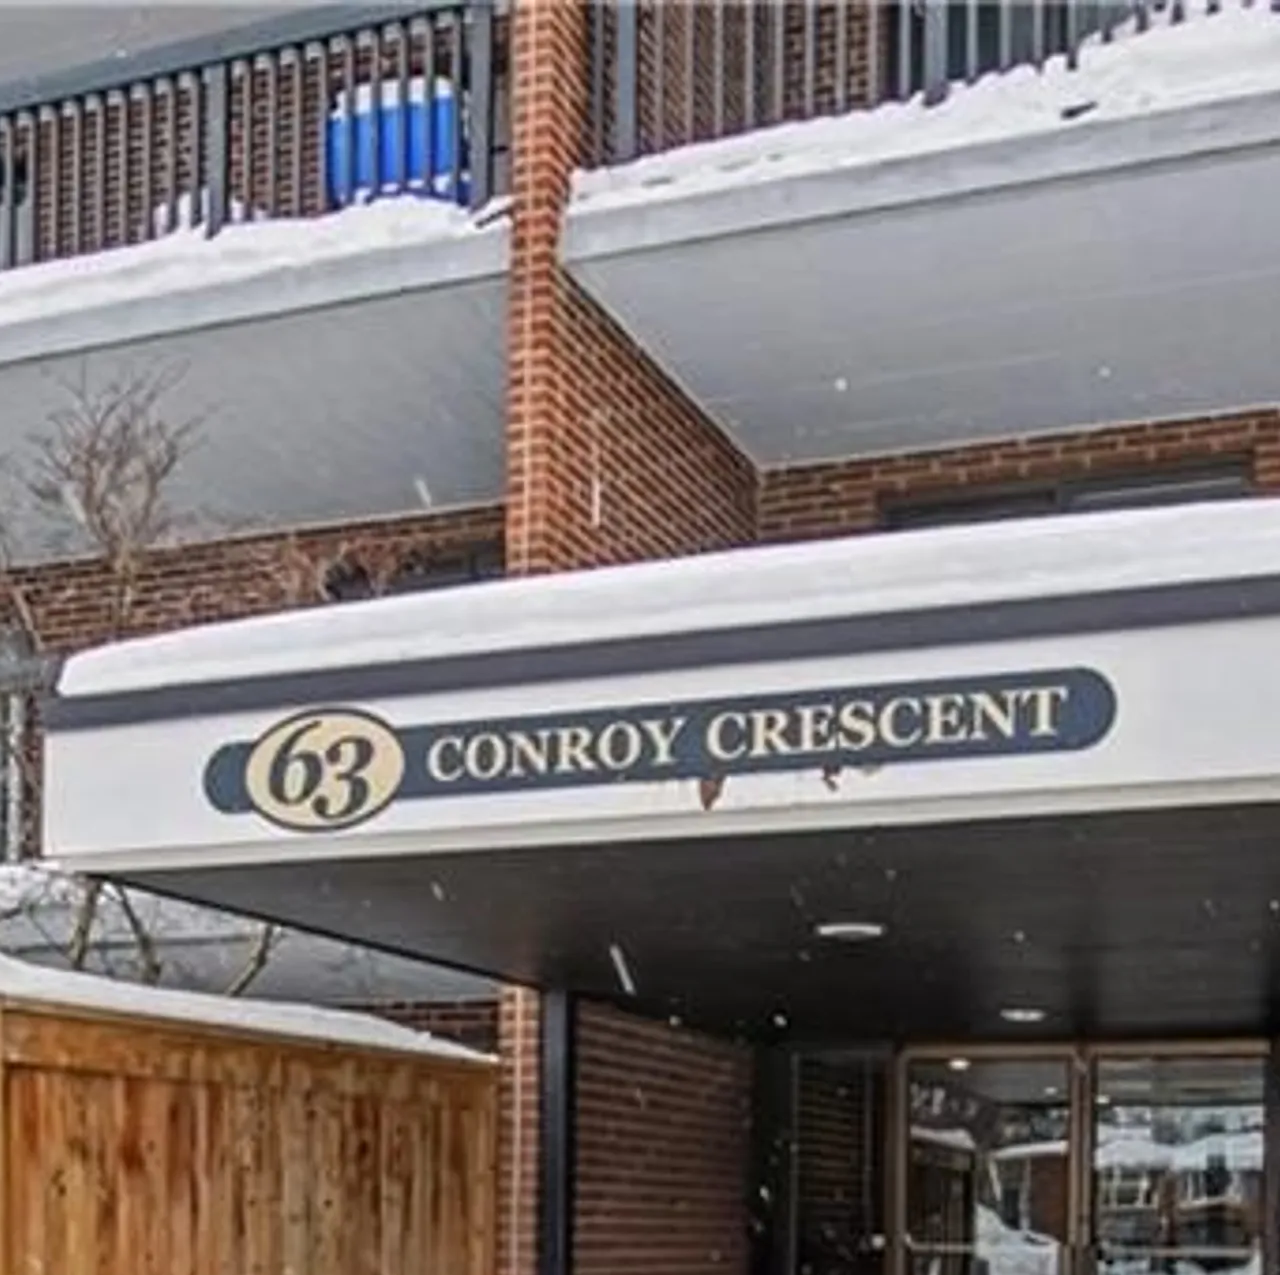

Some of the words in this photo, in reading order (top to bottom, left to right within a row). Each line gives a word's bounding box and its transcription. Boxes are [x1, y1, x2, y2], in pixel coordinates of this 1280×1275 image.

[268, 720, 373, 819] 63
[428, 720, 683, 782] CONROY
[707, 687, 1067, 760] CRESCENT
